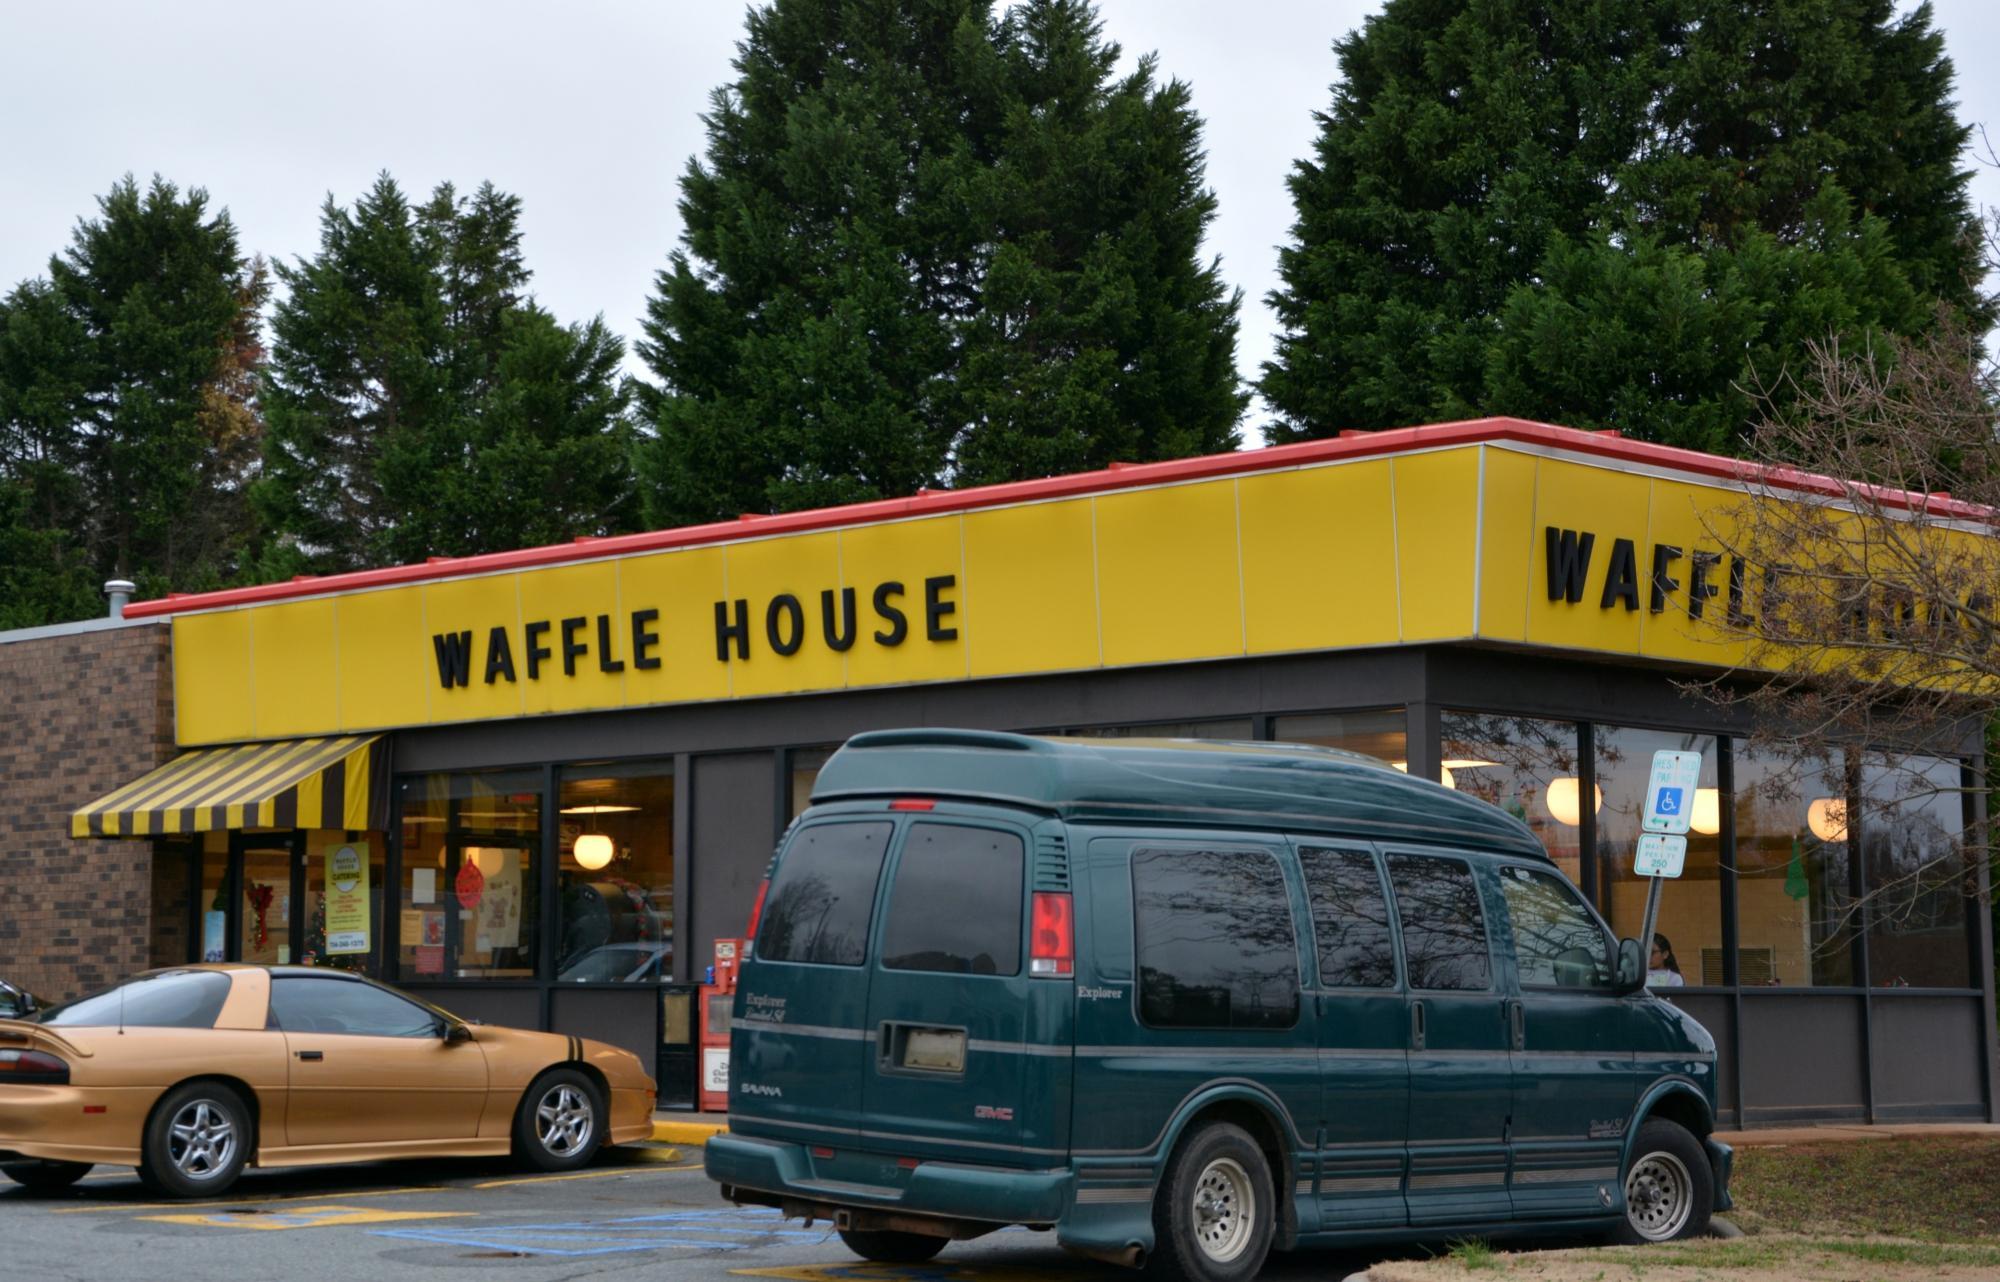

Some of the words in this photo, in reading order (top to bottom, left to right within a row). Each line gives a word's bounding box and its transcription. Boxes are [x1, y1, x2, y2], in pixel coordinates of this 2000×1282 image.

[432, 609, 661, 689] WAFFLE
[714, 574, 958, 662] HOUSE
[745, 992, 786, 1009] Explorer
[1077, 985, 1123, 1001] Explorer
[740, 1083, 782, 1097] SAVANA
[974, 1105, 1013, 1120] GMC
